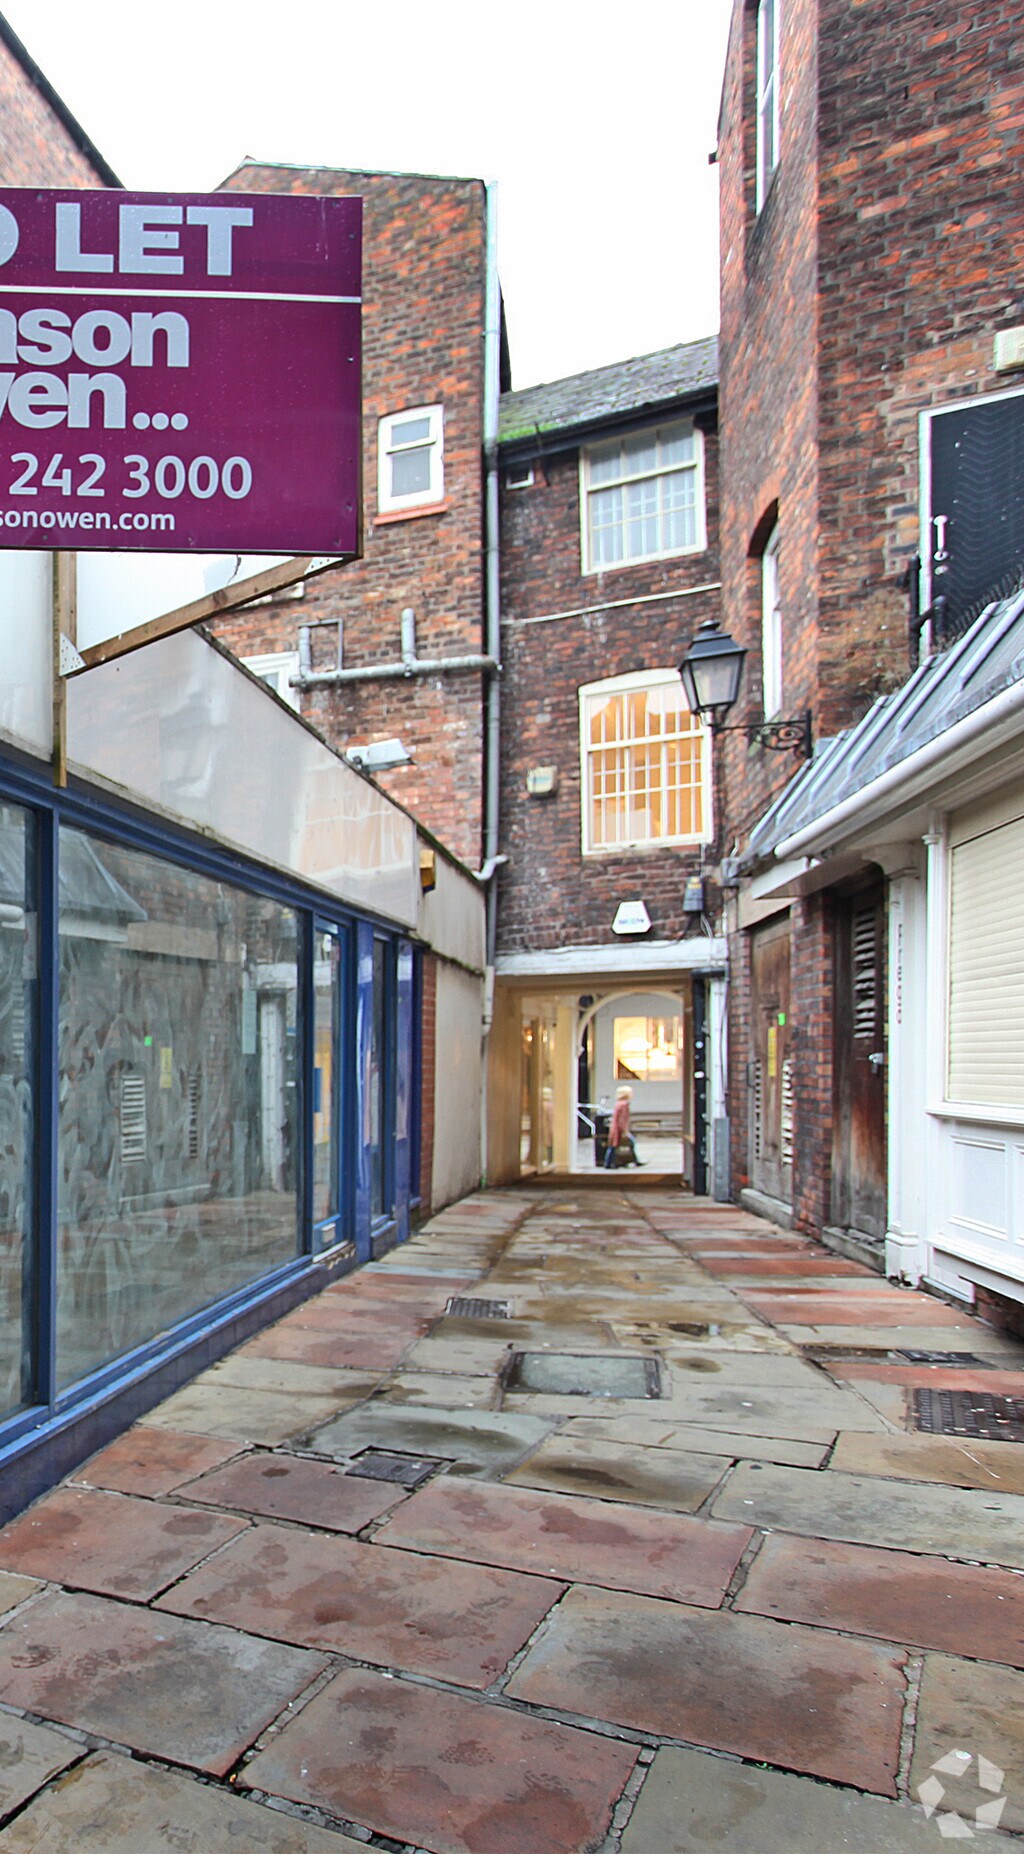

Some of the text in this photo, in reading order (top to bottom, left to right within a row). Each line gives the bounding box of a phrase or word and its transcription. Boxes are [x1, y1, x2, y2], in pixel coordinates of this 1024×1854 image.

[55, 203, 254, 276] LET
[8, 453, 106, 497] 242
[122, 455, 253, 500] 3000
